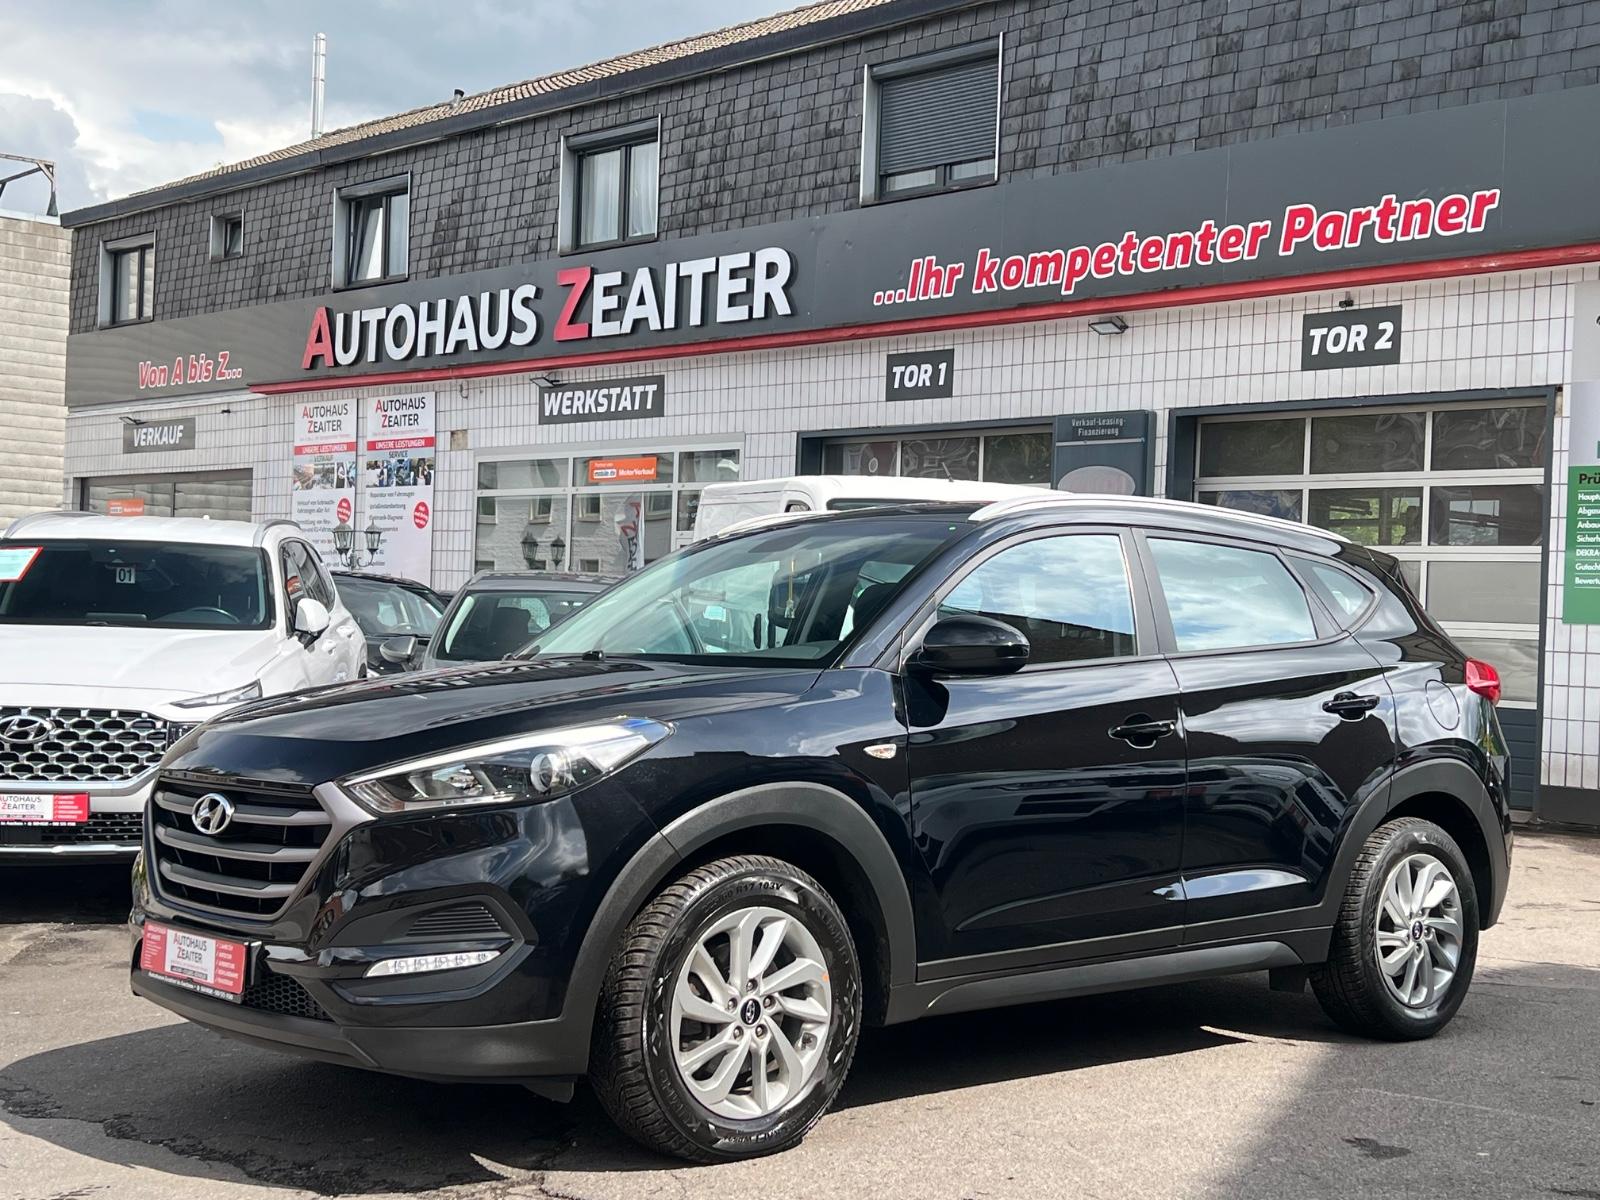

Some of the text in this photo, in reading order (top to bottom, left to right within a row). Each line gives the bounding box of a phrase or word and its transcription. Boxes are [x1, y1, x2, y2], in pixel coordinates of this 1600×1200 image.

[874, 189, 1501, 306] ...Ihr kompetenter Partner
[302, 246, 792, 370] AUTOHAUS ZEAITER
[1309, 321, 1394, 356] TOR 2
[139, 351, 242, 389] Von A bis Z...
[892, 362, 947, 389] TOR 1
[375, 396, 426, 412] AUTOHAUS
[543, 384, 658, 417] WERKSTATT
[302, 403, 349, 419] AUTOHAUS
[307, 419, 342, 434] ZEAITER
[381, 414, 419, 429] ZEAITER
[133, 425, 184, 447] VERKAUF
[1078, 427, 1119, 437] Finanzierung
[375, 439, 425, 450] UNSERE LEISTUNGEN
[389, 450, 408, 458] SERVICE
[118, 567, 133, 582] 01
[758, 881, 783, 892] 103V
[173, 932, 208, 952] AUTOHAUS
[177, 946, 203, 963] ZEAITER
